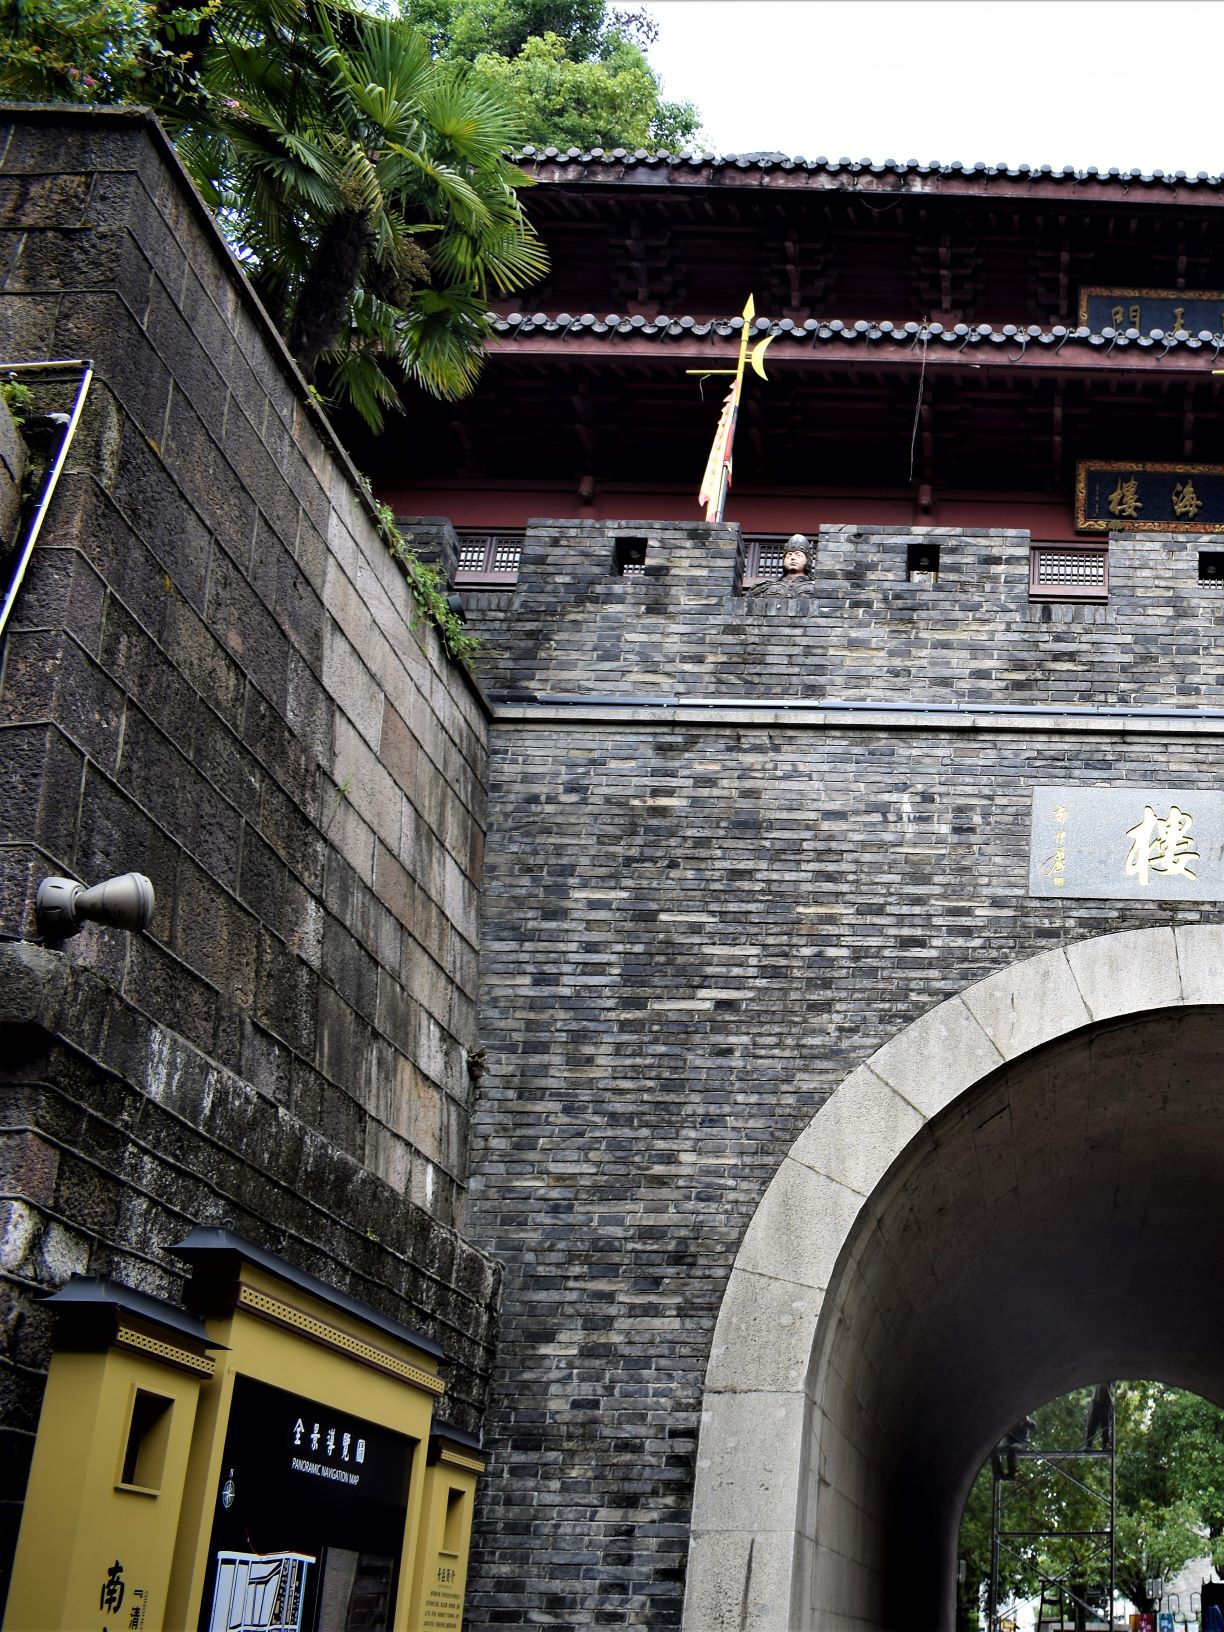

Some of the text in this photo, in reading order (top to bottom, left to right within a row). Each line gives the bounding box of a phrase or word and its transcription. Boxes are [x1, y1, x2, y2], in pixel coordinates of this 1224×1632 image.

[291, 1457, 360, 1485] PANORAMIC NAVIGATION MAP
